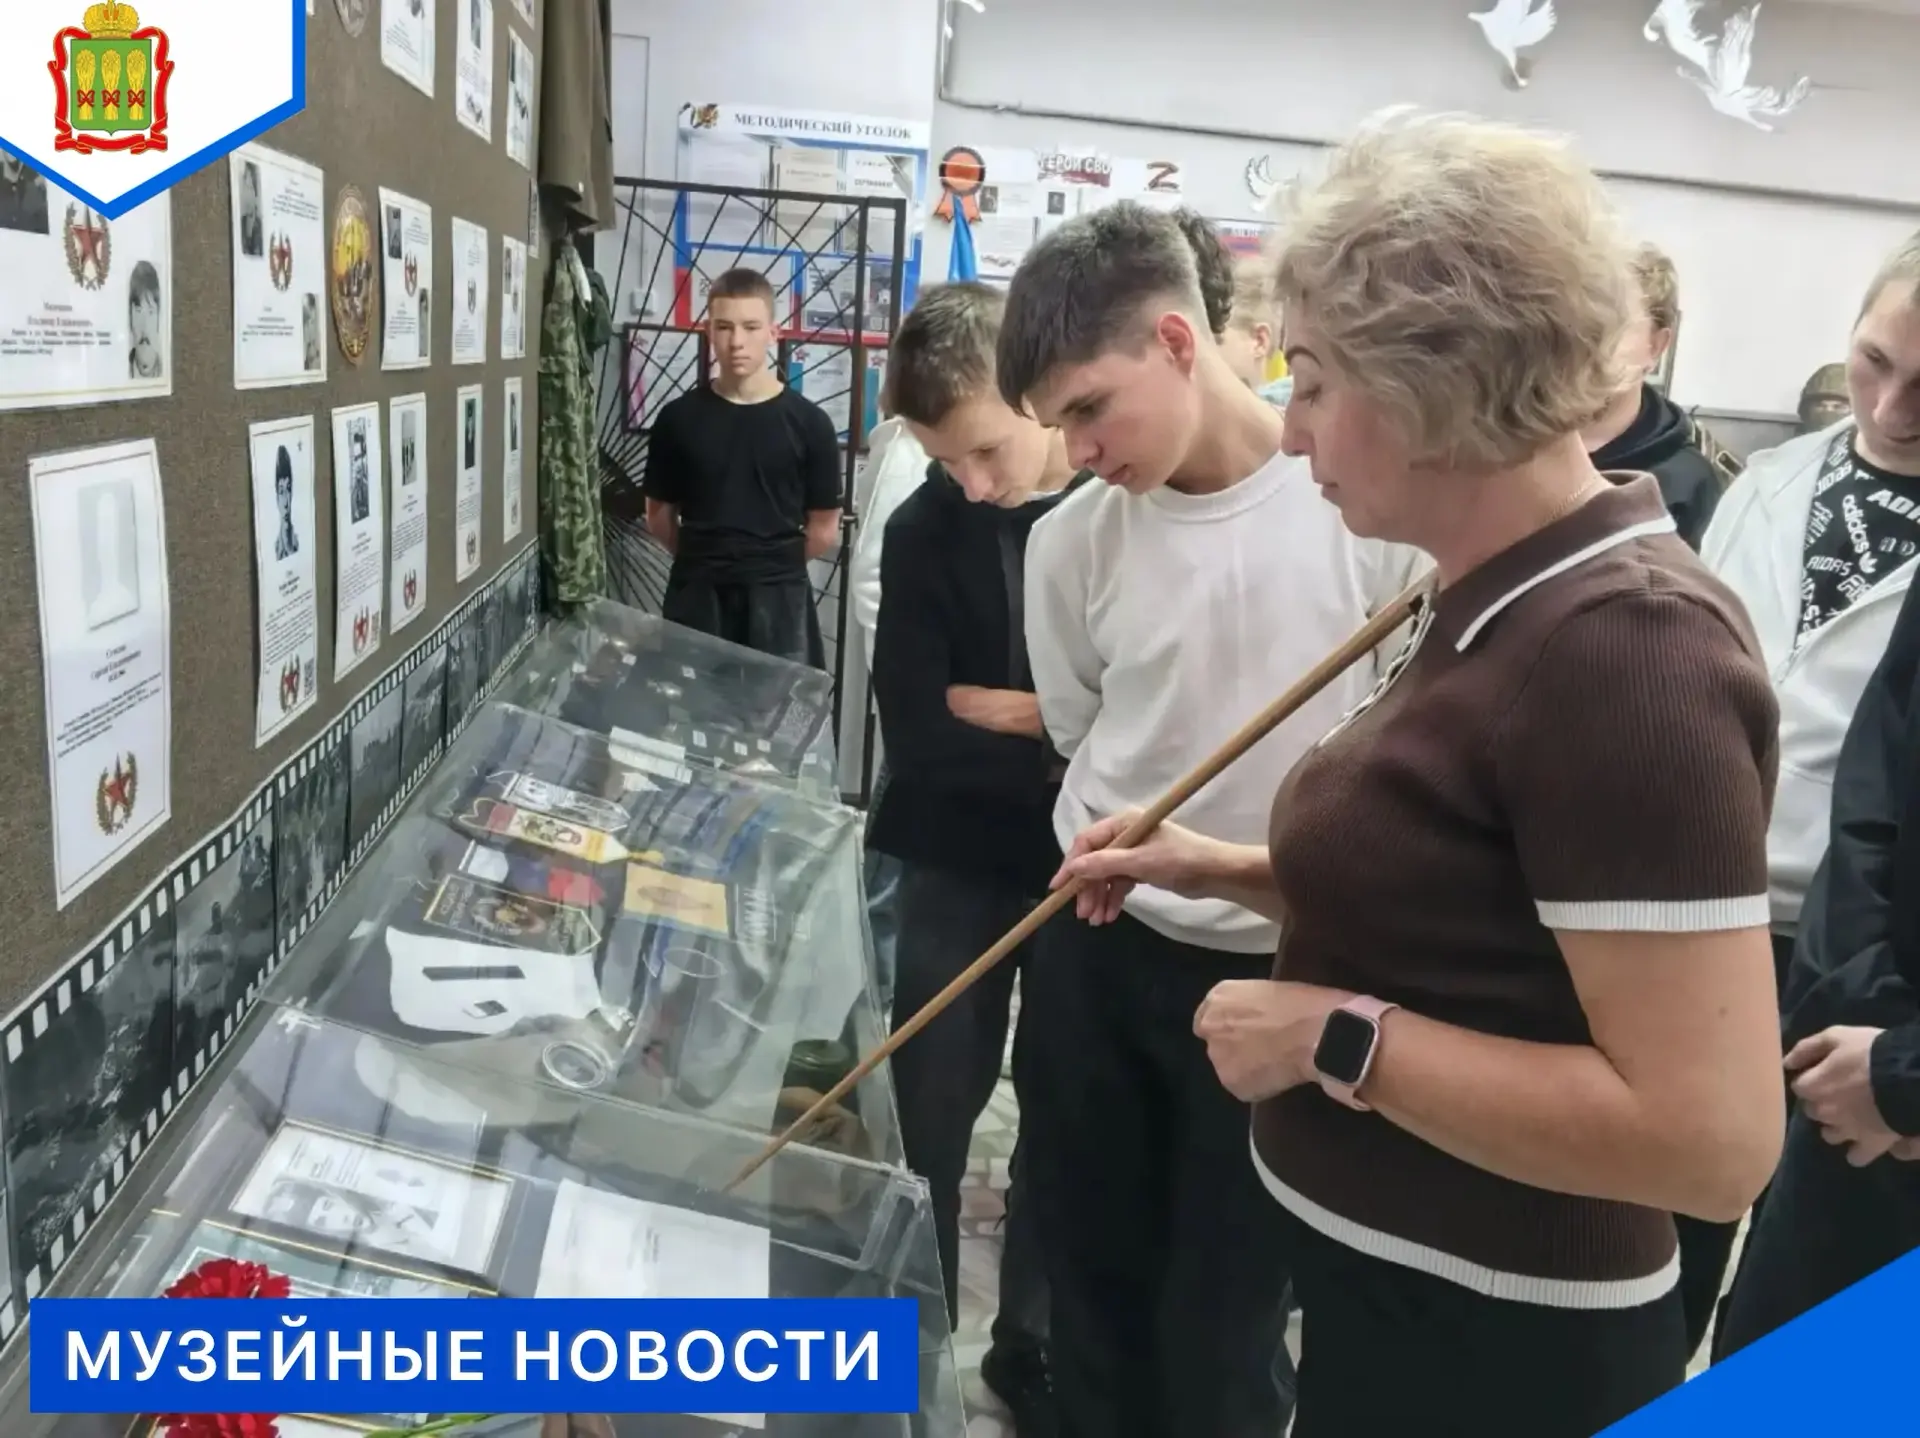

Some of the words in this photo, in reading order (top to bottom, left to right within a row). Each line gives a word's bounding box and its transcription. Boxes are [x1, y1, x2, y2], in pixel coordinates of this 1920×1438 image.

[734, 112, 851, 134] МЕТОДИЧЕСКИЙ
[856, 124, 912, 139] УГОЛОК
[1842, 494, 1870, 554] adidas
